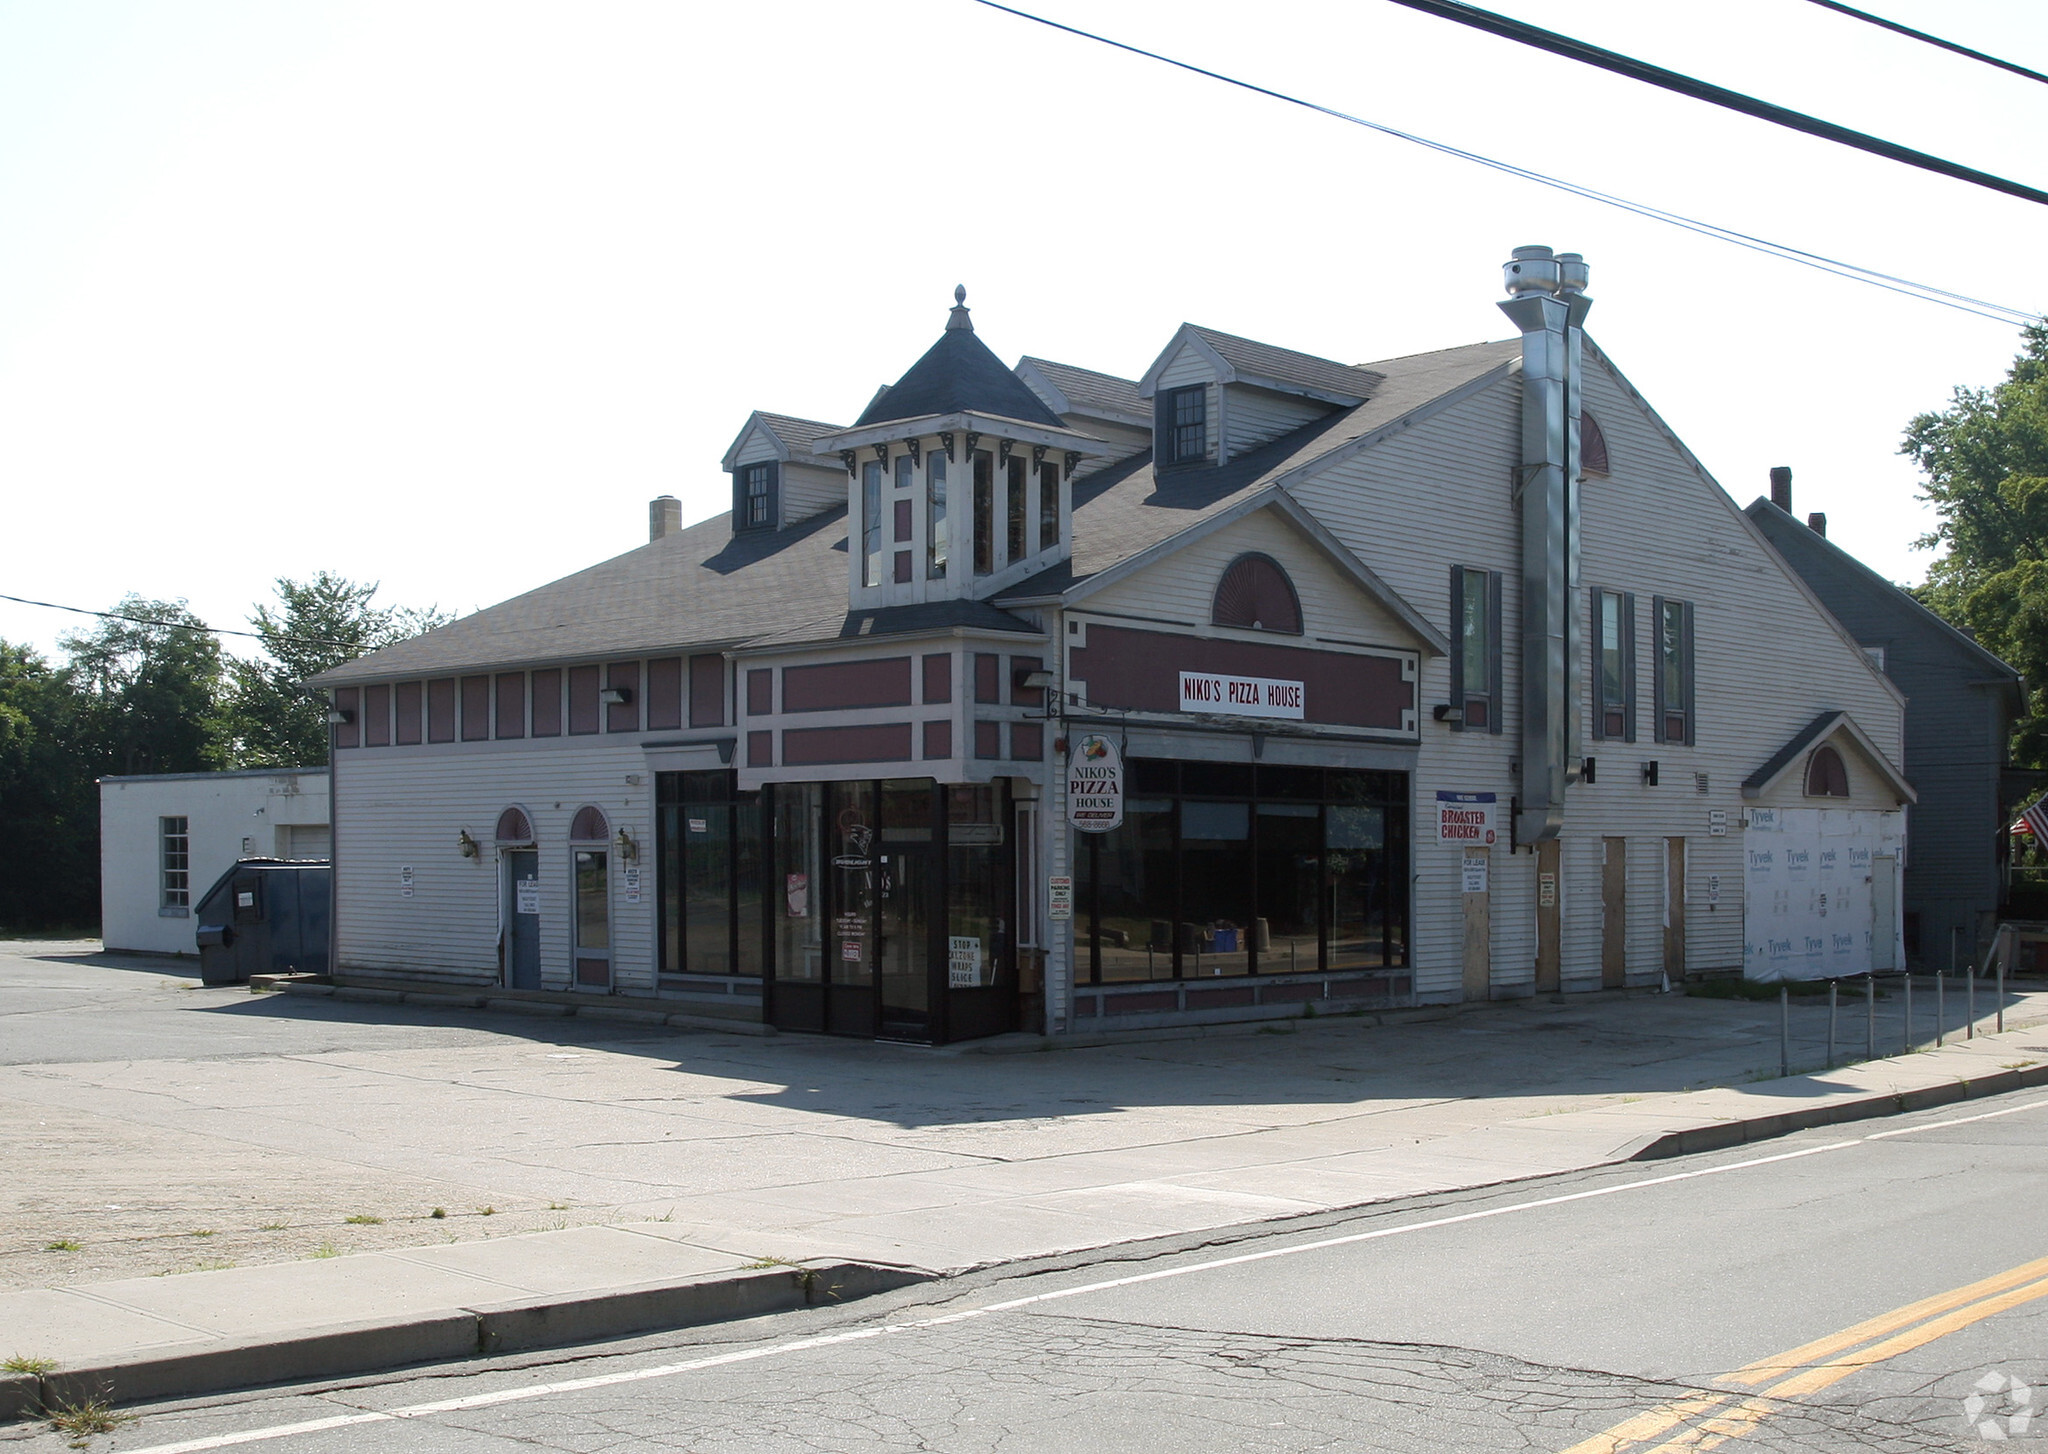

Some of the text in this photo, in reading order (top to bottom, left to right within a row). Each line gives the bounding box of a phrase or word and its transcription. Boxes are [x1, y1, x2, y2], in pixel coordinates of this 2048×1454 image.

[1184, 677, 1301, 708] NIKO'S PIZZA HOUSE
[1074, 766, 1117, 779] NIKO'S
[1069, 780, 1119, 795] PIZZA
[1075, 797, 1115, 808] HOUSE
[1441, 809, 1486, 825] BROASTER
[1750, 808, 1774, 825] Tyvek
[1441, 824, 1480, 839] CHICKEN
[1749, 849, 1773, 867] Tyvek
[1786, 849, 1809, 865] Tyvek
[1848, 847, 1870, 863] Tyvek
[953, 940, 971, 950] STOP
[1768, 938, 1792, 956] Tyvek
[1832, 932, 1853, 950] Tyvek
[951, 972, 973, 983] SLICE
